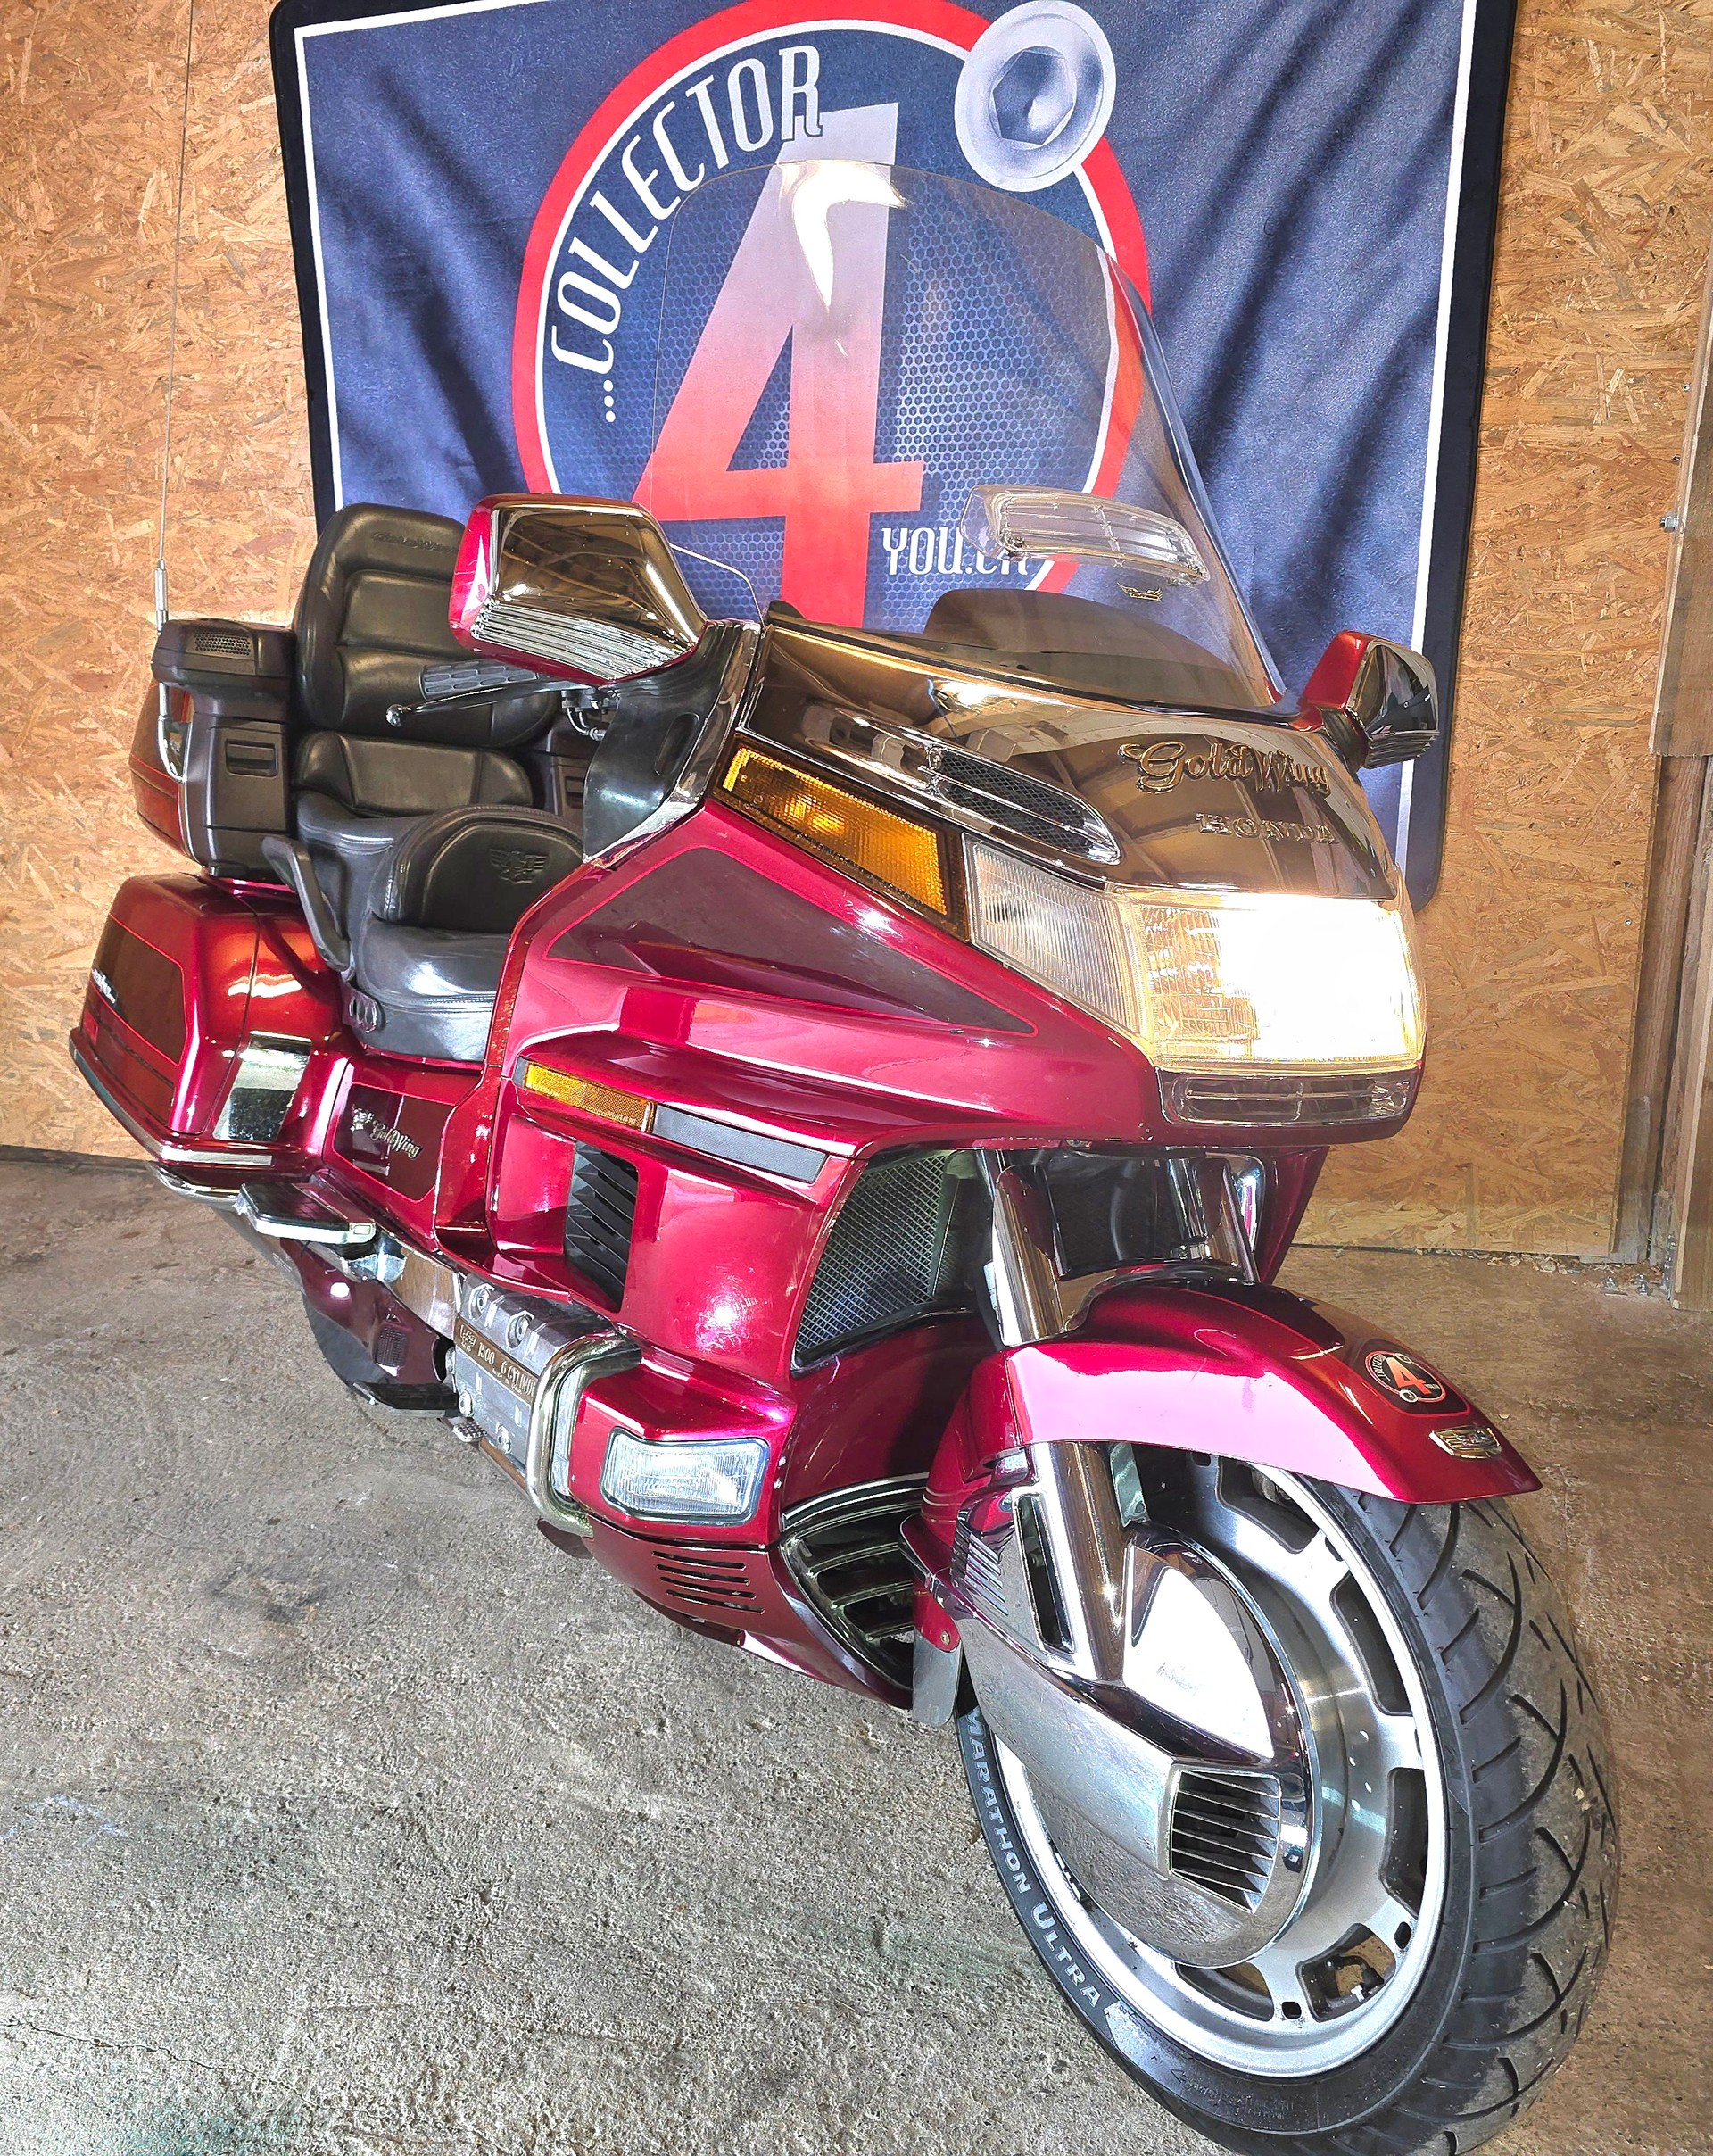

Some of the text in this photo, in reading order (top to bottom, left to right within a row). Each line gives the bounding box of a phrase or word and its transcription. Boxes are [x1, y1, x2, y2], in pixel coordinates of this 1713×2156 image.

[630, 101, 925, 628] 4
[1196, 812, 1337, 844] HONDA
[477, 1341, 495, 1365] 1500
[966, 1705, 1102, 2008] MARATHON ULTRA
